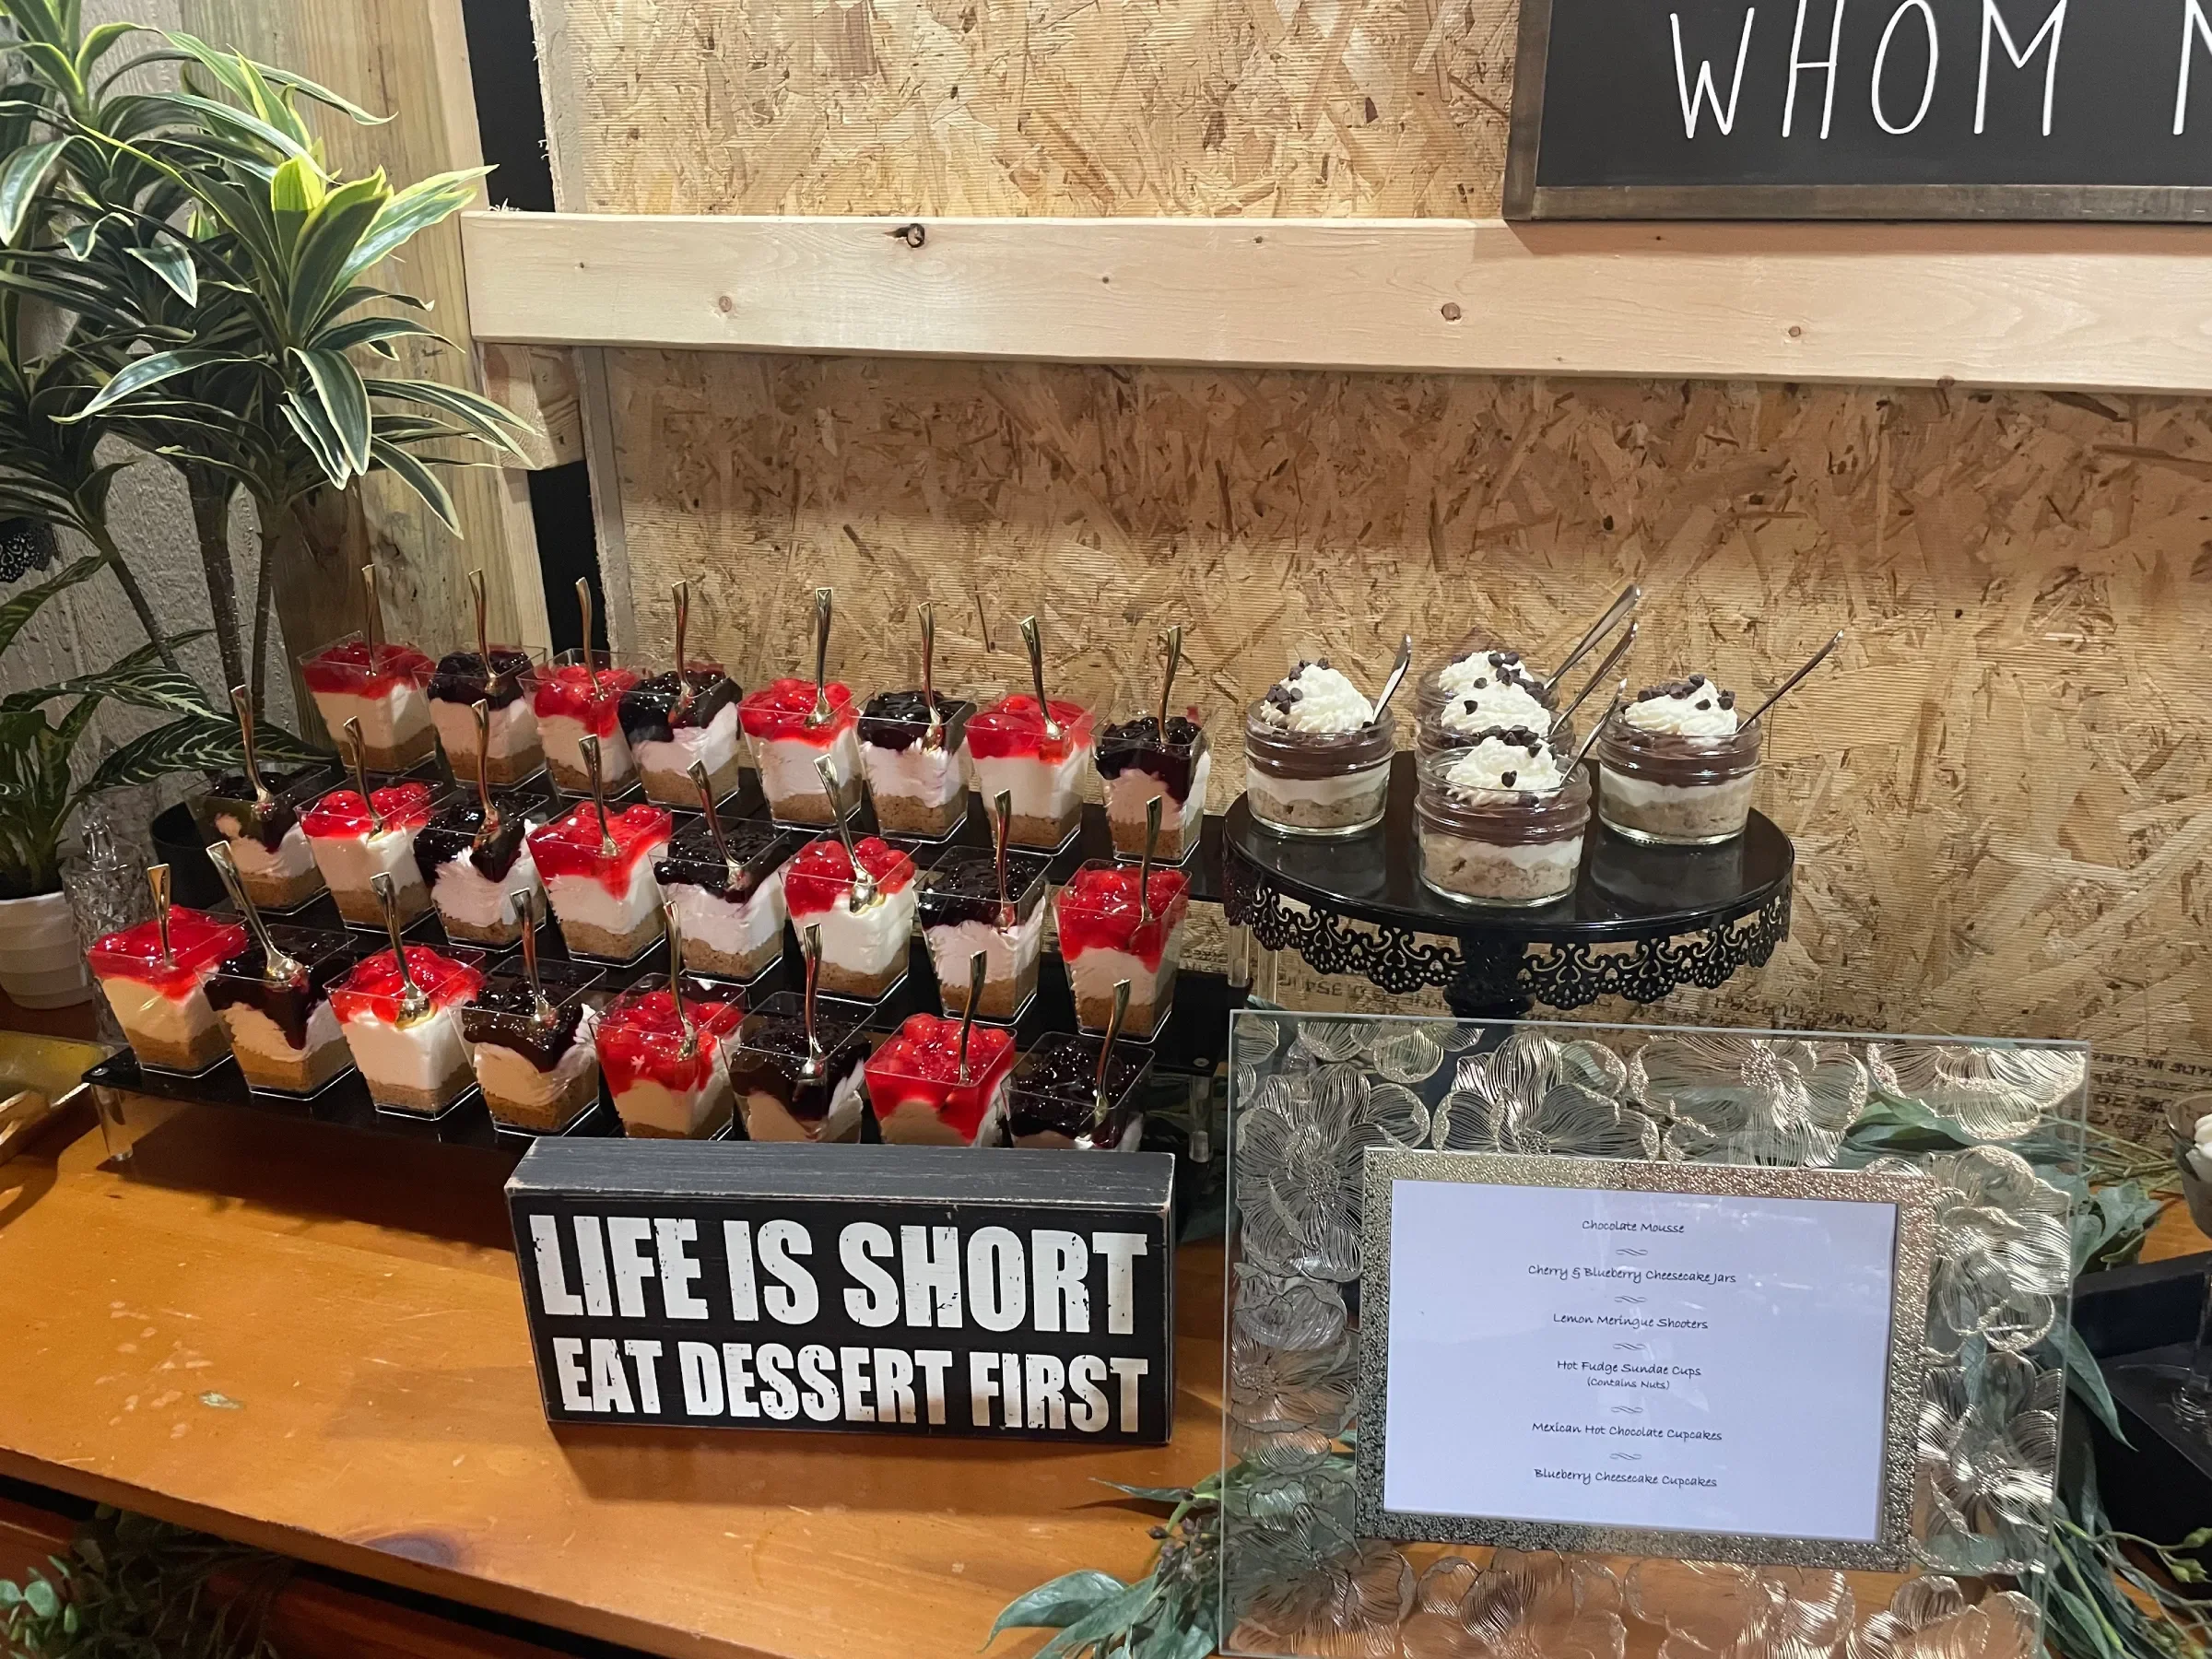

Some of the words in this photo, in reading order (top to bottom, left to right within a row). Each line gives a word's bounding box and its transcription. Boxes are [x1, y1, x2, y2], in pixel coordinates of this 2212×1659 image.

[1670, 0, 2067, 139] WHOM
[1582, 1219, 1638, 1232] Chocolate
[1640, 1223, 1685, 1234] Mousse
[529, 1215, 709, 1321] LIFE
[724, 1219, 820, 1325] IS
[840, 1222, 1148, 1335] SHORT
[1528, 1264, 1569, 1281] Cherry
[1571, 1266, 1581, 1280] &
[1583, 1266, 1641, 1285] Blueberry
[1645, 1269, 1710, 1283] Cheesecake
[1709, 1273, 1736, 1286] Jars
[1553, 1312, 1594, 1324] Lemon
[1596, 1314, 1654, 1330] Meringue
[1655, 1317, 1709, 1330] Shooters
[1557, 1359, 1579, 1371] Hot
[1581, 1360, 1618, 1375] Fudge
[1620, 1363, 1669, 1375] Sundae
[1671, 1365, 1702, 1380] Cups
[552, 1337, 664, 1415] EAT
[678, 1341, 953, 1426] DESSERT
[970, 1351, 1149, 1433] FIRST
[1586, 1376, 1638, 1388] (Contains
[1640, 1380, 1670, 1391] Nuts)
[1531, 1421, 1583, 1434] Mexican
[1584, 1424, 1606, 1435] Hot
[1608, 1425, 1664, 1439] Chocolate
[1666, 1429, 1723, 1443] Cupcakes
[1533, 1467, 1592, 1486] Blueberry
[1594, 1471, 1659, 1485] Cheesecake
[1661, 1475, 1718, 1489] Cupcakes
